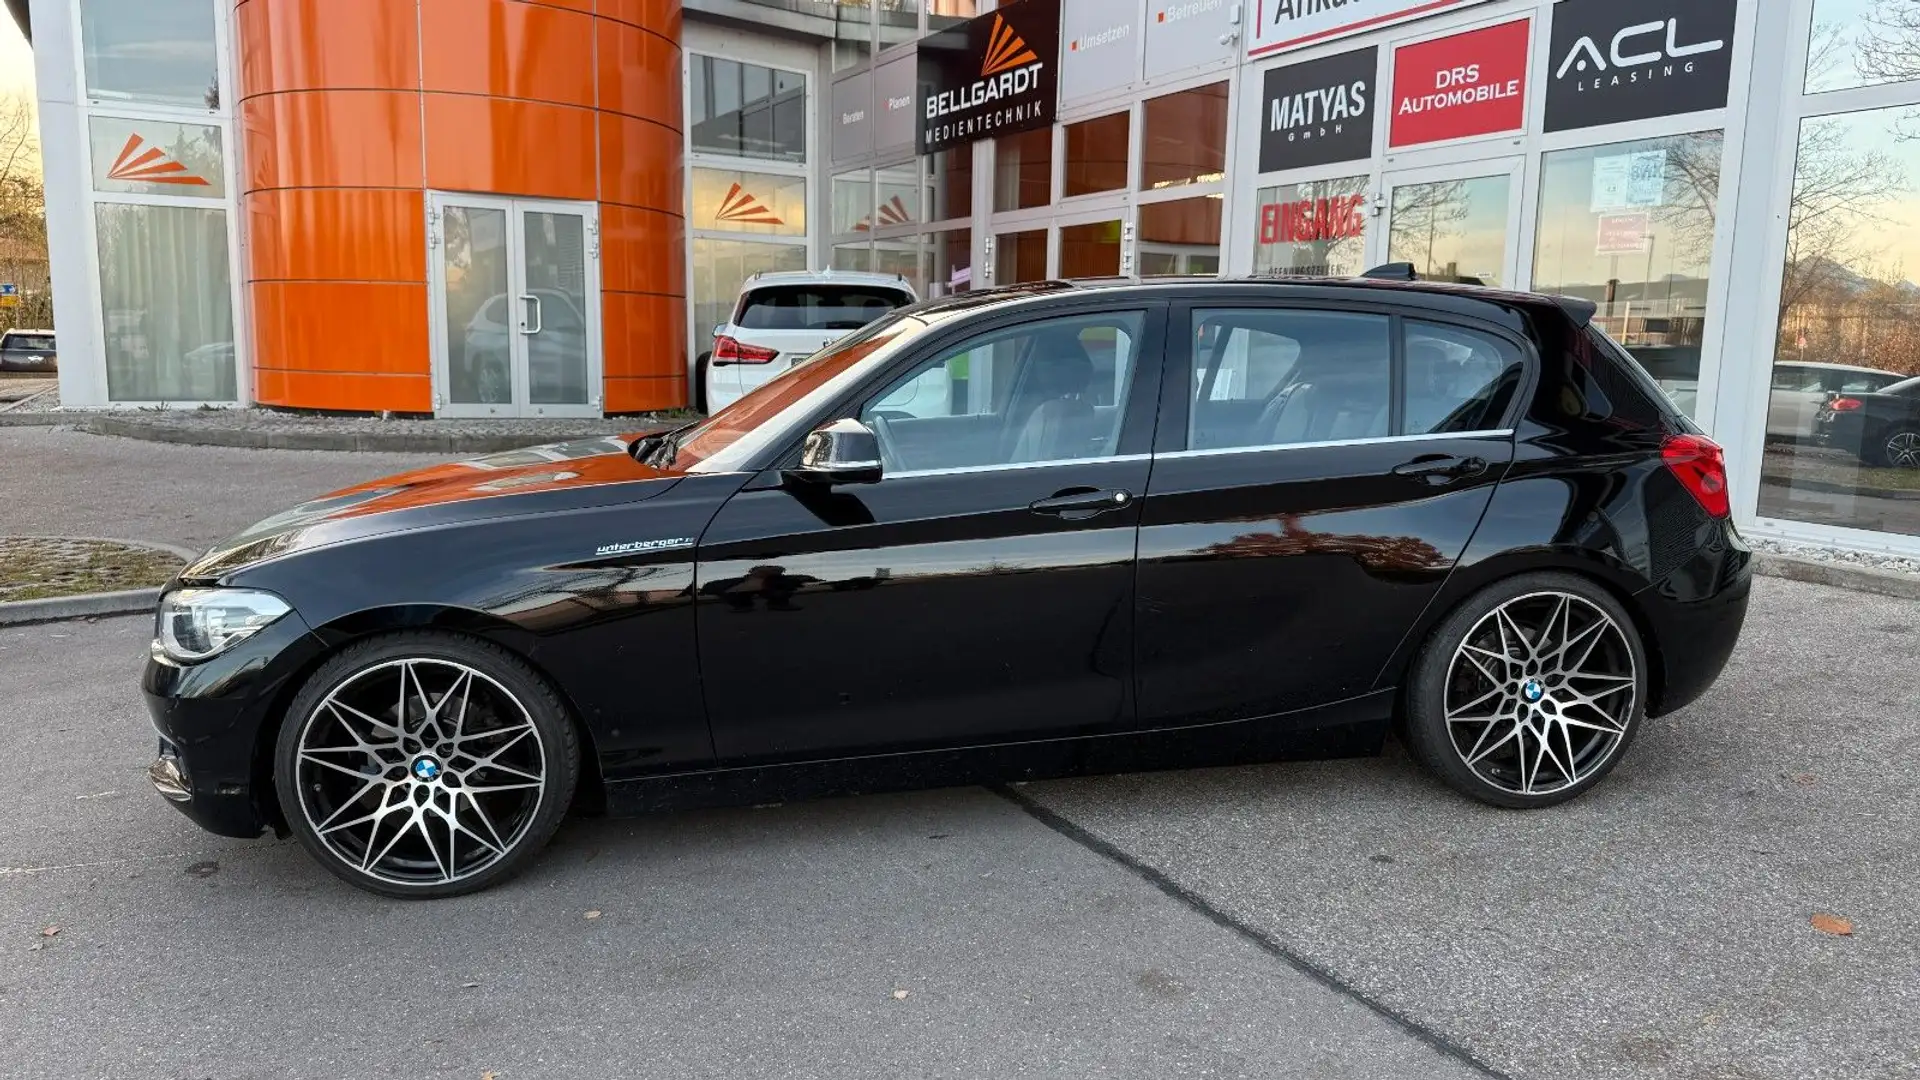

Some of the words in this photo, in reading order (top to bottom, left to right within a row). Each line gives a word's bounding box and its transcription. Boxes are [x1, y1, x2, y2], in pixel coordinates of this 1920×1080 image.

[1167, 0, 1222, 22] Betreuen
[1079, 24, 1130, 50] Umsetzen
[1556, 18, 1723, 79] ACL
[926, 62, 1043, 119] BELLGARDT
[1436, 64, 1480, 89] DRS
[1578, 62, 1693, 91] LEASING
[1270, 80, 1366, 131] MATYAS
[925, 100, 1041, 144] MEDIENTECHNIK
[1288, 124, 1342, 141] GmbH
[1260, 194, 1363, 244] EINGANG
[597, 537, 683, 552] unterberger
